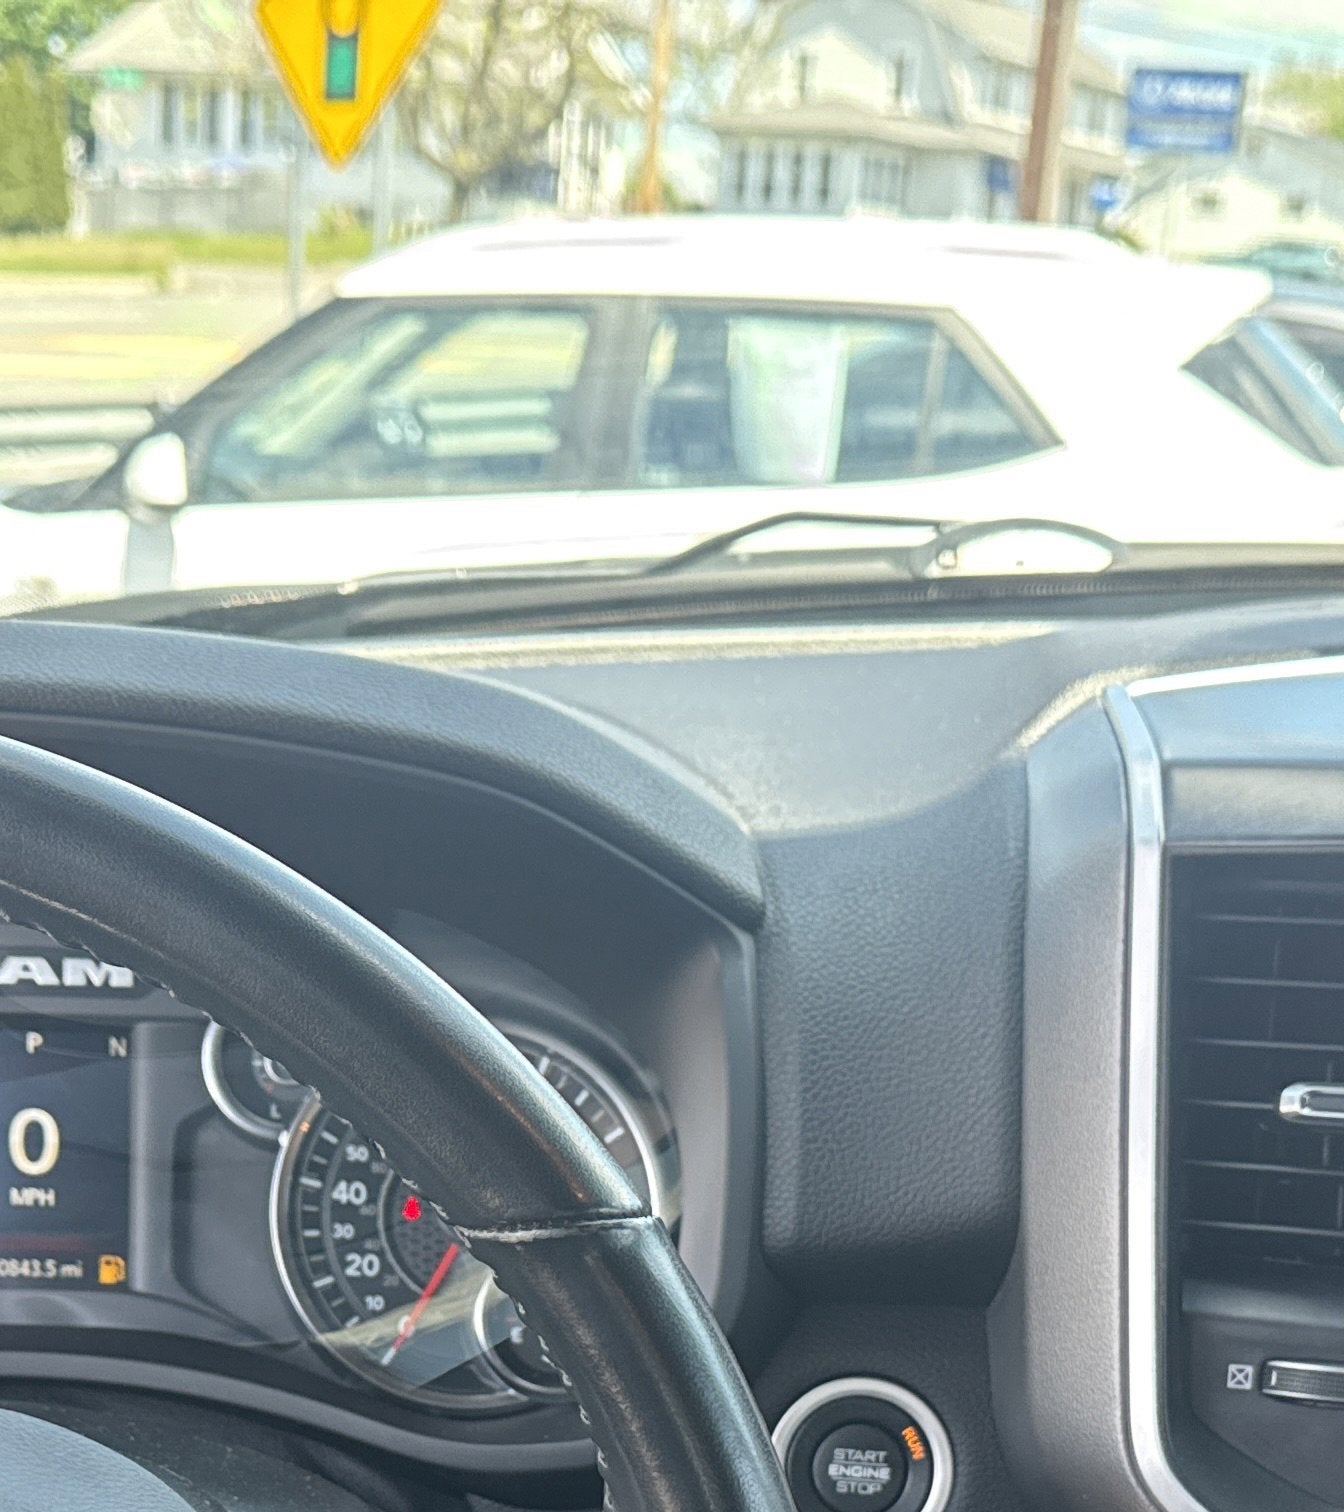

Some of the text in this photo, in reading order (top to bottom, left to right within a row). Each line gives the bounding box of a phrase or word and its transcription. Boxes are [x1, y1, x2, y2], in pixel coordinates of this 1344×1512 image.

[25, 1031, 44, 1054] P
[108, 1036, 128, 1057] N
[8, 1107, 60, 1176] 0
[345, 1144, 369, 1162] 50
[9, 1187, 56, 1207] MPH
[331, 1180, 367, 1205] 40
[333, 1222, 354, 1239] 30
[59, 1259, 83, 1278] mi
[344, 1253, 380, 1277] 20
[365, 1295, 385, 1311] 10
[901, 1425, 926, 1461] RUN
[834, 1447, 887, 1462] START
[828, 1463, 890, 1480] ENGINE
[835, 1480, 882, 1495] STOP
